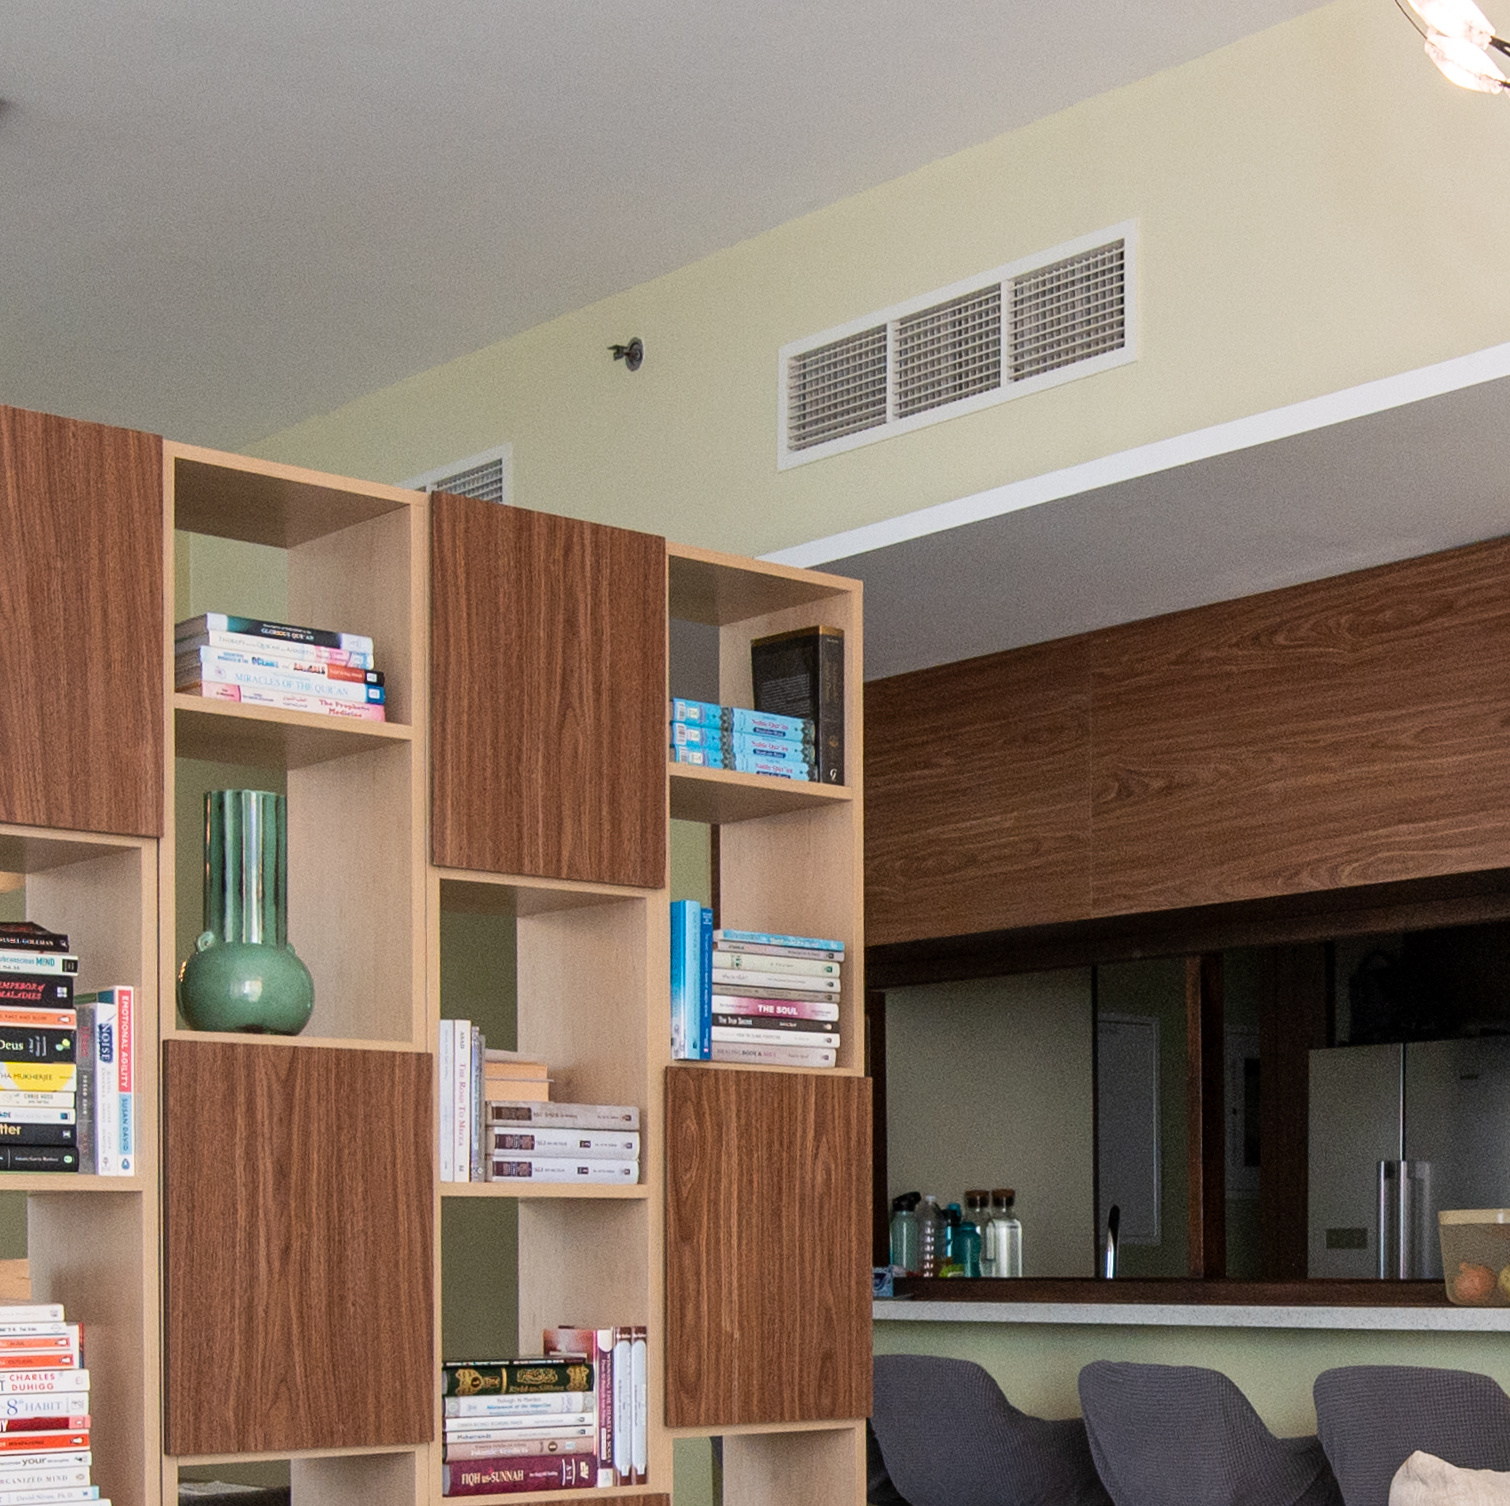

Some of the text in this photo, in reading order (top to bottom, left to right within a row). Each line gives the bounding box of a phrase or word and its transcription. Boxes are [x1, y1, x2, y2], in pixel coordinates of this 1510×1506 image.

[235, 672, 349, 696] MIRACLES OF THE QUR'AN
[319, 699, 333, 707] The
[36, 957, 55, 967] MIND
[757, 1004, 799, 1016] THE SOUL
[101, 1023, 111, 1060] NOISE
[120, 995, 130, 1088] EMOTIONAL AGILITY
[13, 1073, 53, 1082] MUKHERJEE
[9, 1373, 55, 1381] CHARLES
[11, 1383, 54, 1391] DUHIGG
[25, 1401, 62, 1411] HABIT
[21, 1457, 47, 1467] your
[46, 1474, 68, 1482] MIND
[461, 1473, 481, 1486] FIQH
[16, 1494, 36, 1502] David
